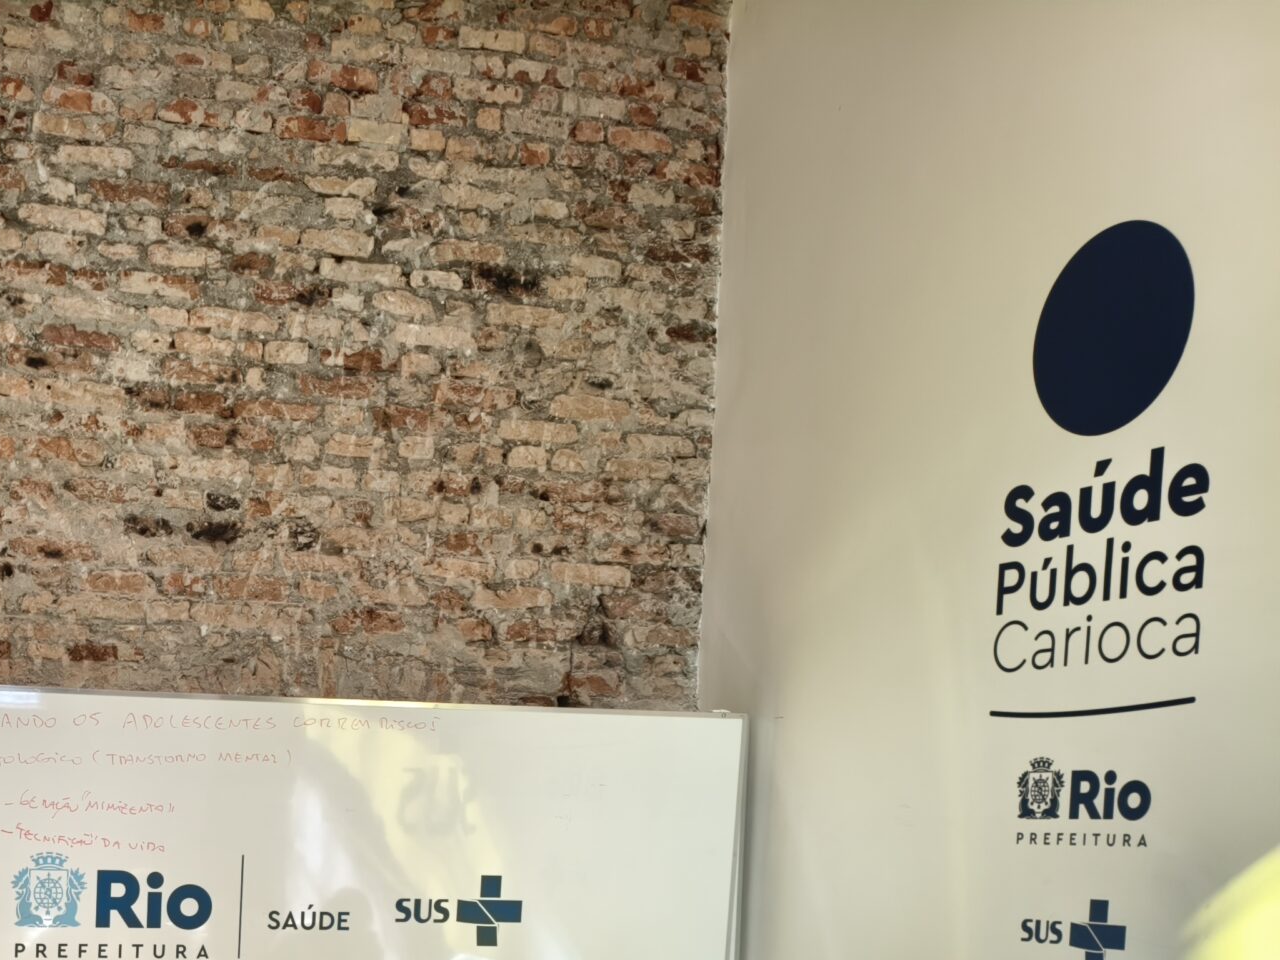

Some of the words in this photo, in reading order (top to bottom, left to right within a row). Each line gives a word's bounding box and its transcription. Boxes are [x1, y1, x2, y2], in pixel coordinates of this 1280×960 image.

[1001, 446, 1210, 547] Saúde
[996, 537, 1205, 616] Pública
[993, 613, 1201, 673] Carioca
[73, 711, 102, 726] OS
[122, 712, 278, 731] ADOLESCENTES
[1068, 769, 1152, 822] Rio
[1015, 832, 1148, 848] PREFEITURA
[95, 870, 213, 930] Rio
[395, 898, 450, 923] SUS
[267, 905, 350, 931] SAÚDE
[1020, 918, 1063, 944] SUS
[14, 942, 210, 960] PREFEITURA
